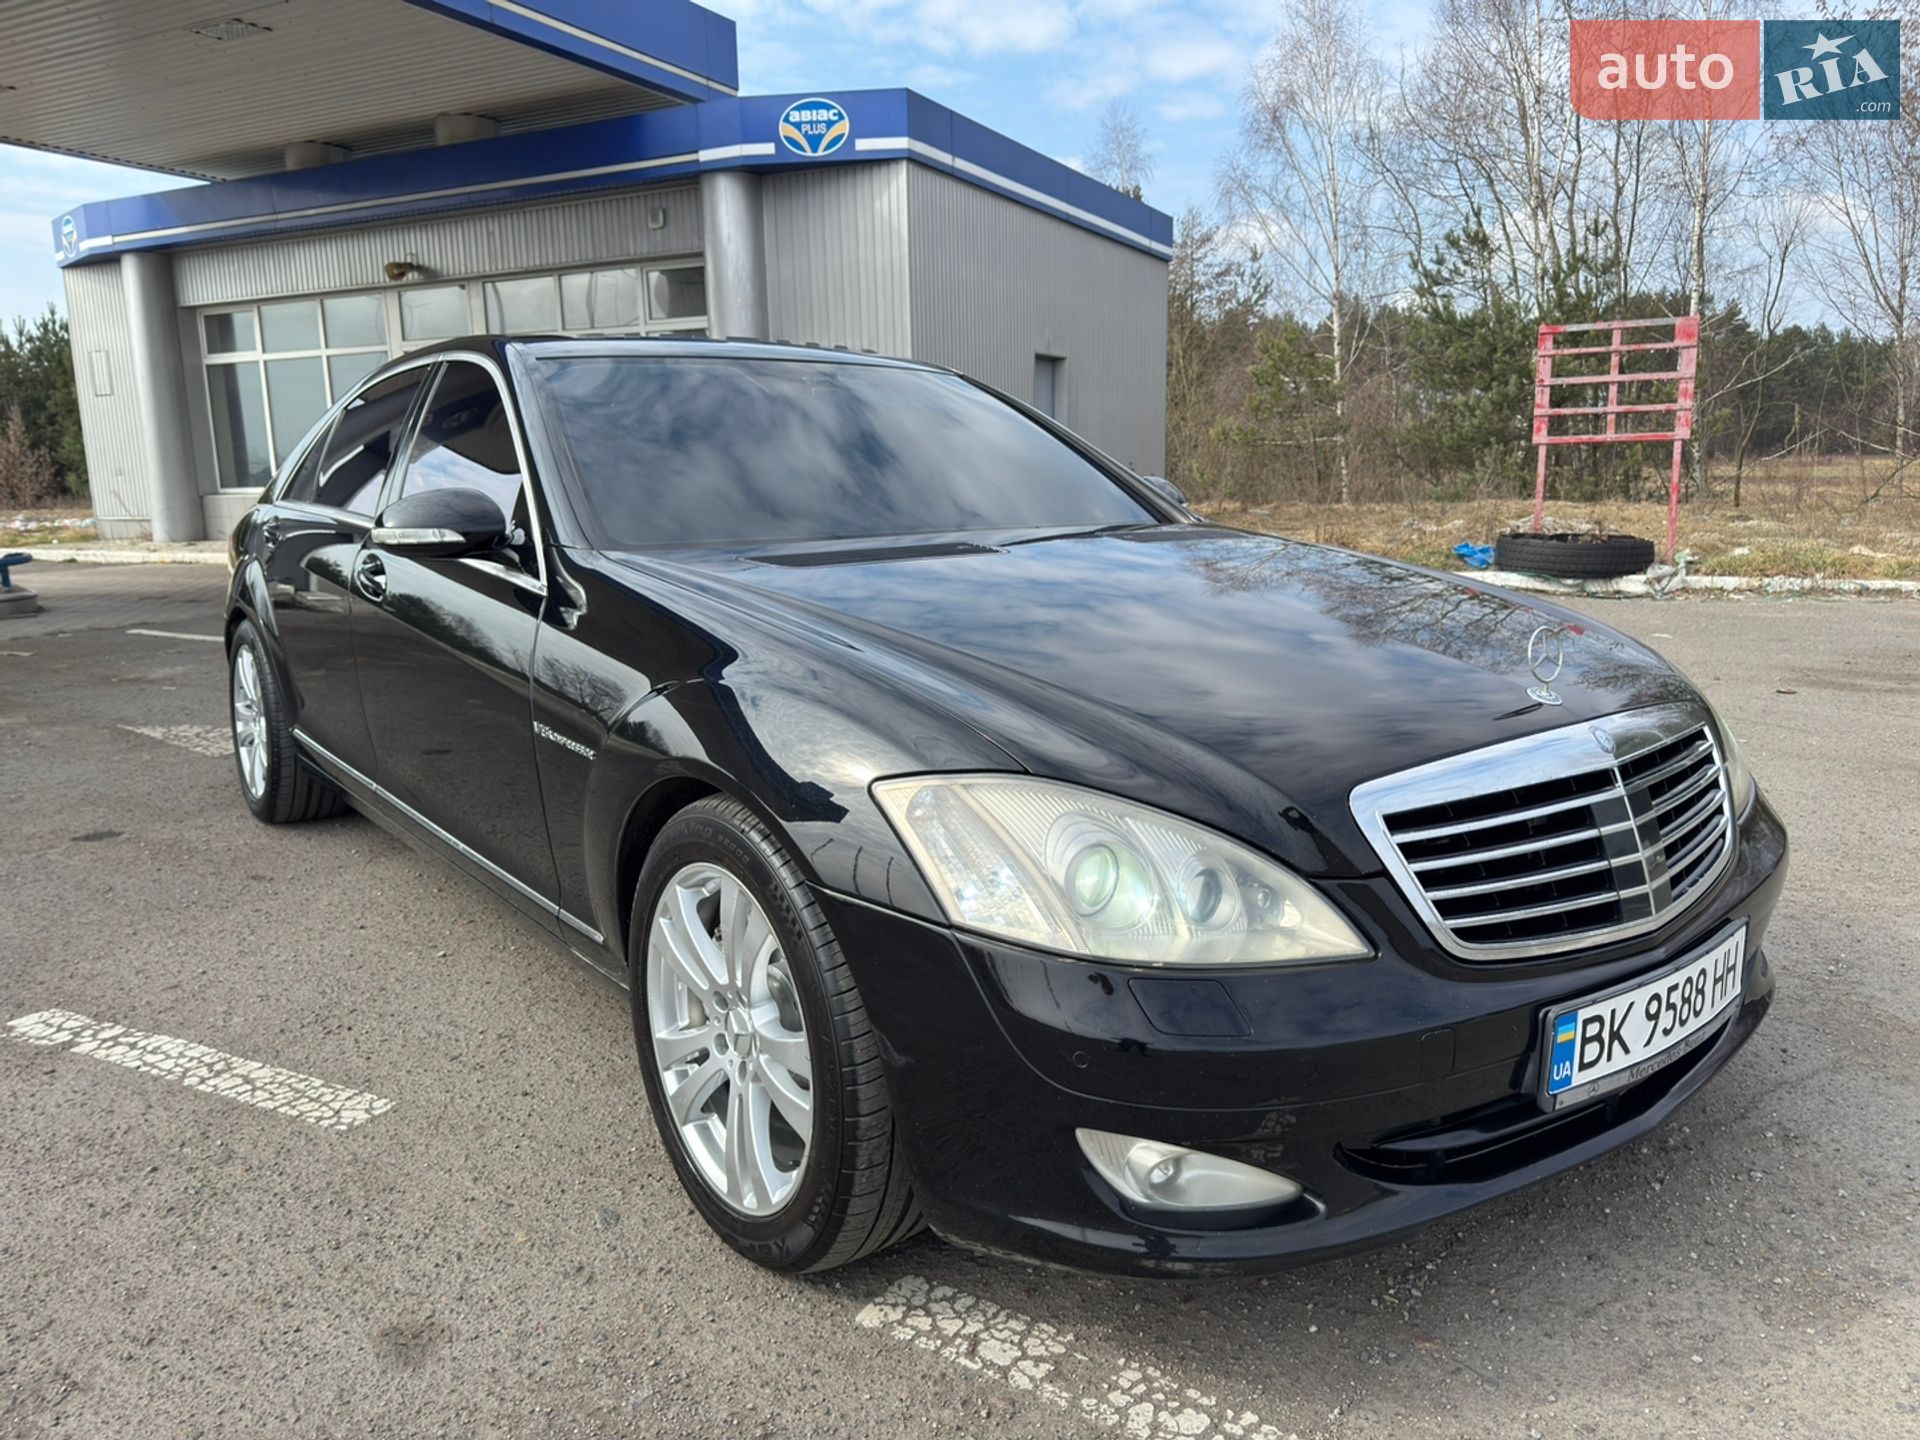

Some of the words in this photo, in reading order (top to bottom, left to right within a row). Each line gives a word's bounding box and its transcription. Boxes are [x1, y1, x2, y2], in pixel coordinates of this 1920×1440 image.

[801, 123, 827, 135] PLUS
[1577, 1000, 1636, 1073] BK
[1643, 967, 1707, 1048] 9588
[1711, 940, 1740, 1009] HH
[1553, 1060, 1571, 1081] UA
